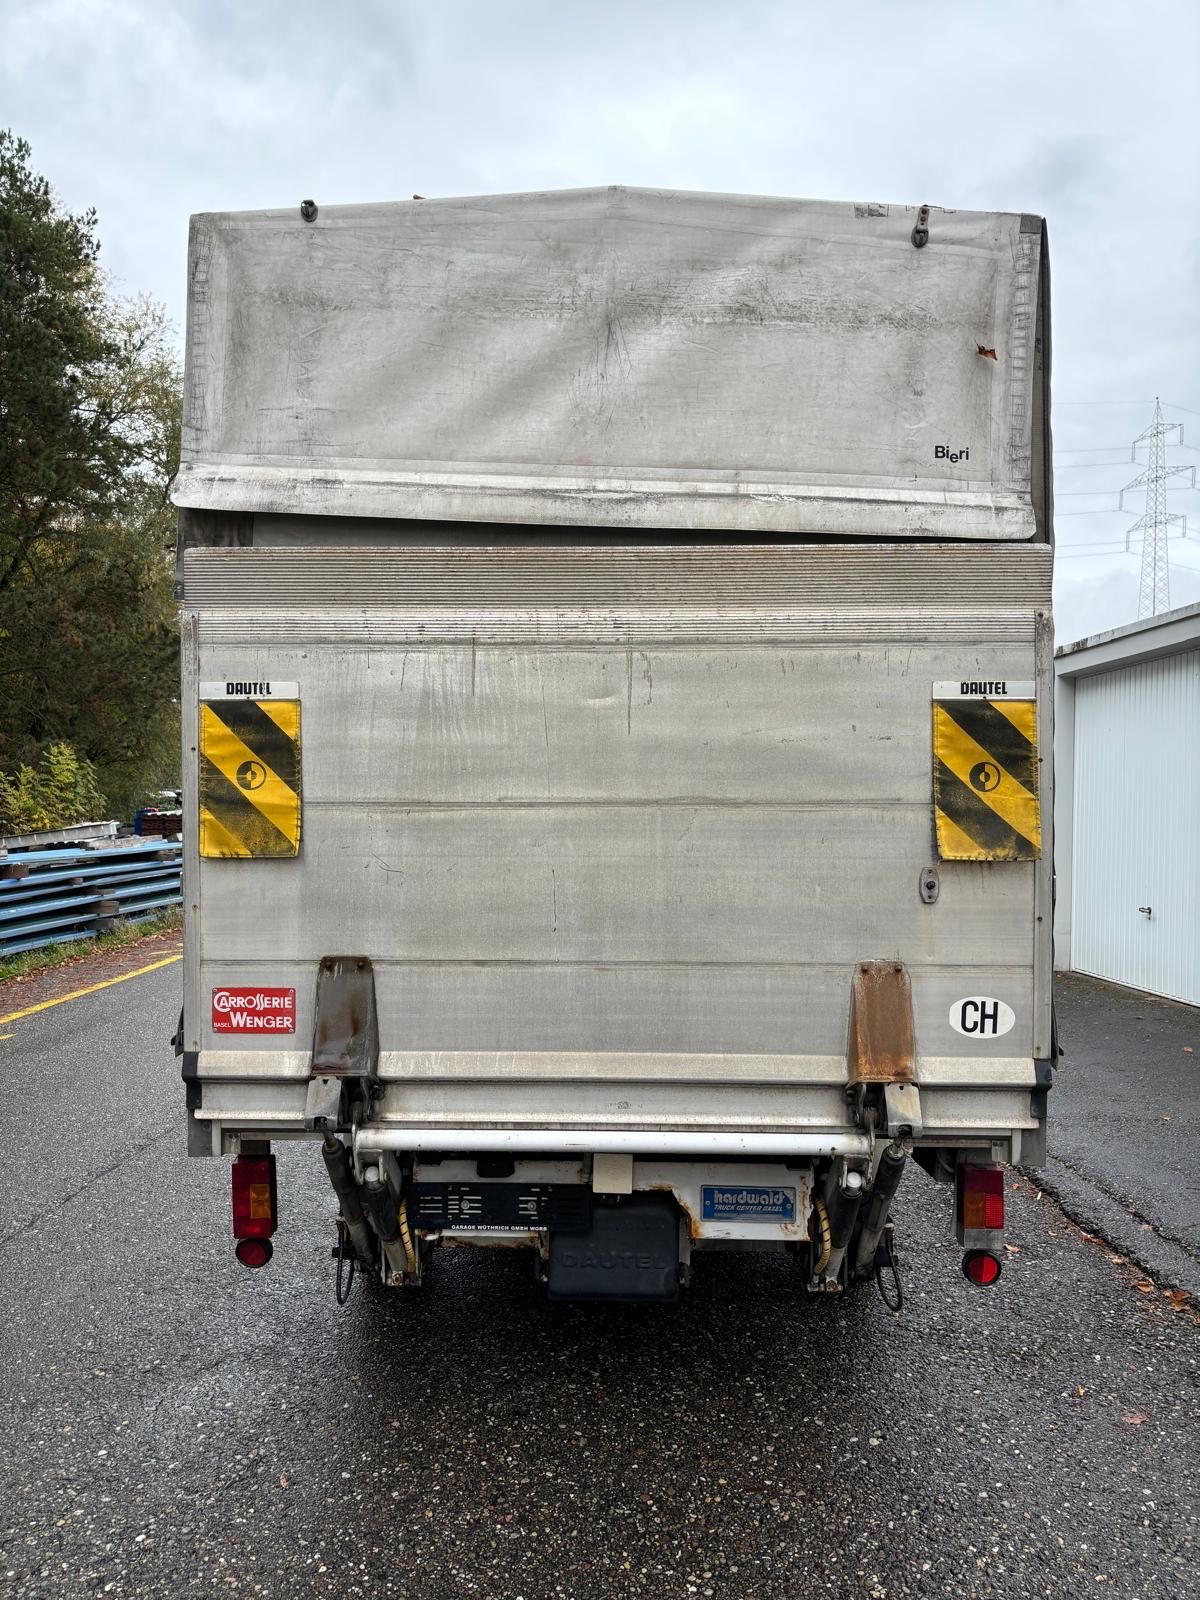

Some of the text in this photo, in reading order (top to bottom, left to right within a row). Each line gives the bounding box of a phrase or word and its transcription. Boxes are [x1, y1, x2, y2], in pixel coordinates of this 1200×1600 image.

[934, 445, 969, 463] Bieri
[226, 682, 272, 695] DAUTEL
[960, 682, 1008, 695] DAUTEL
[961, 1000, 999, 1034] CH
